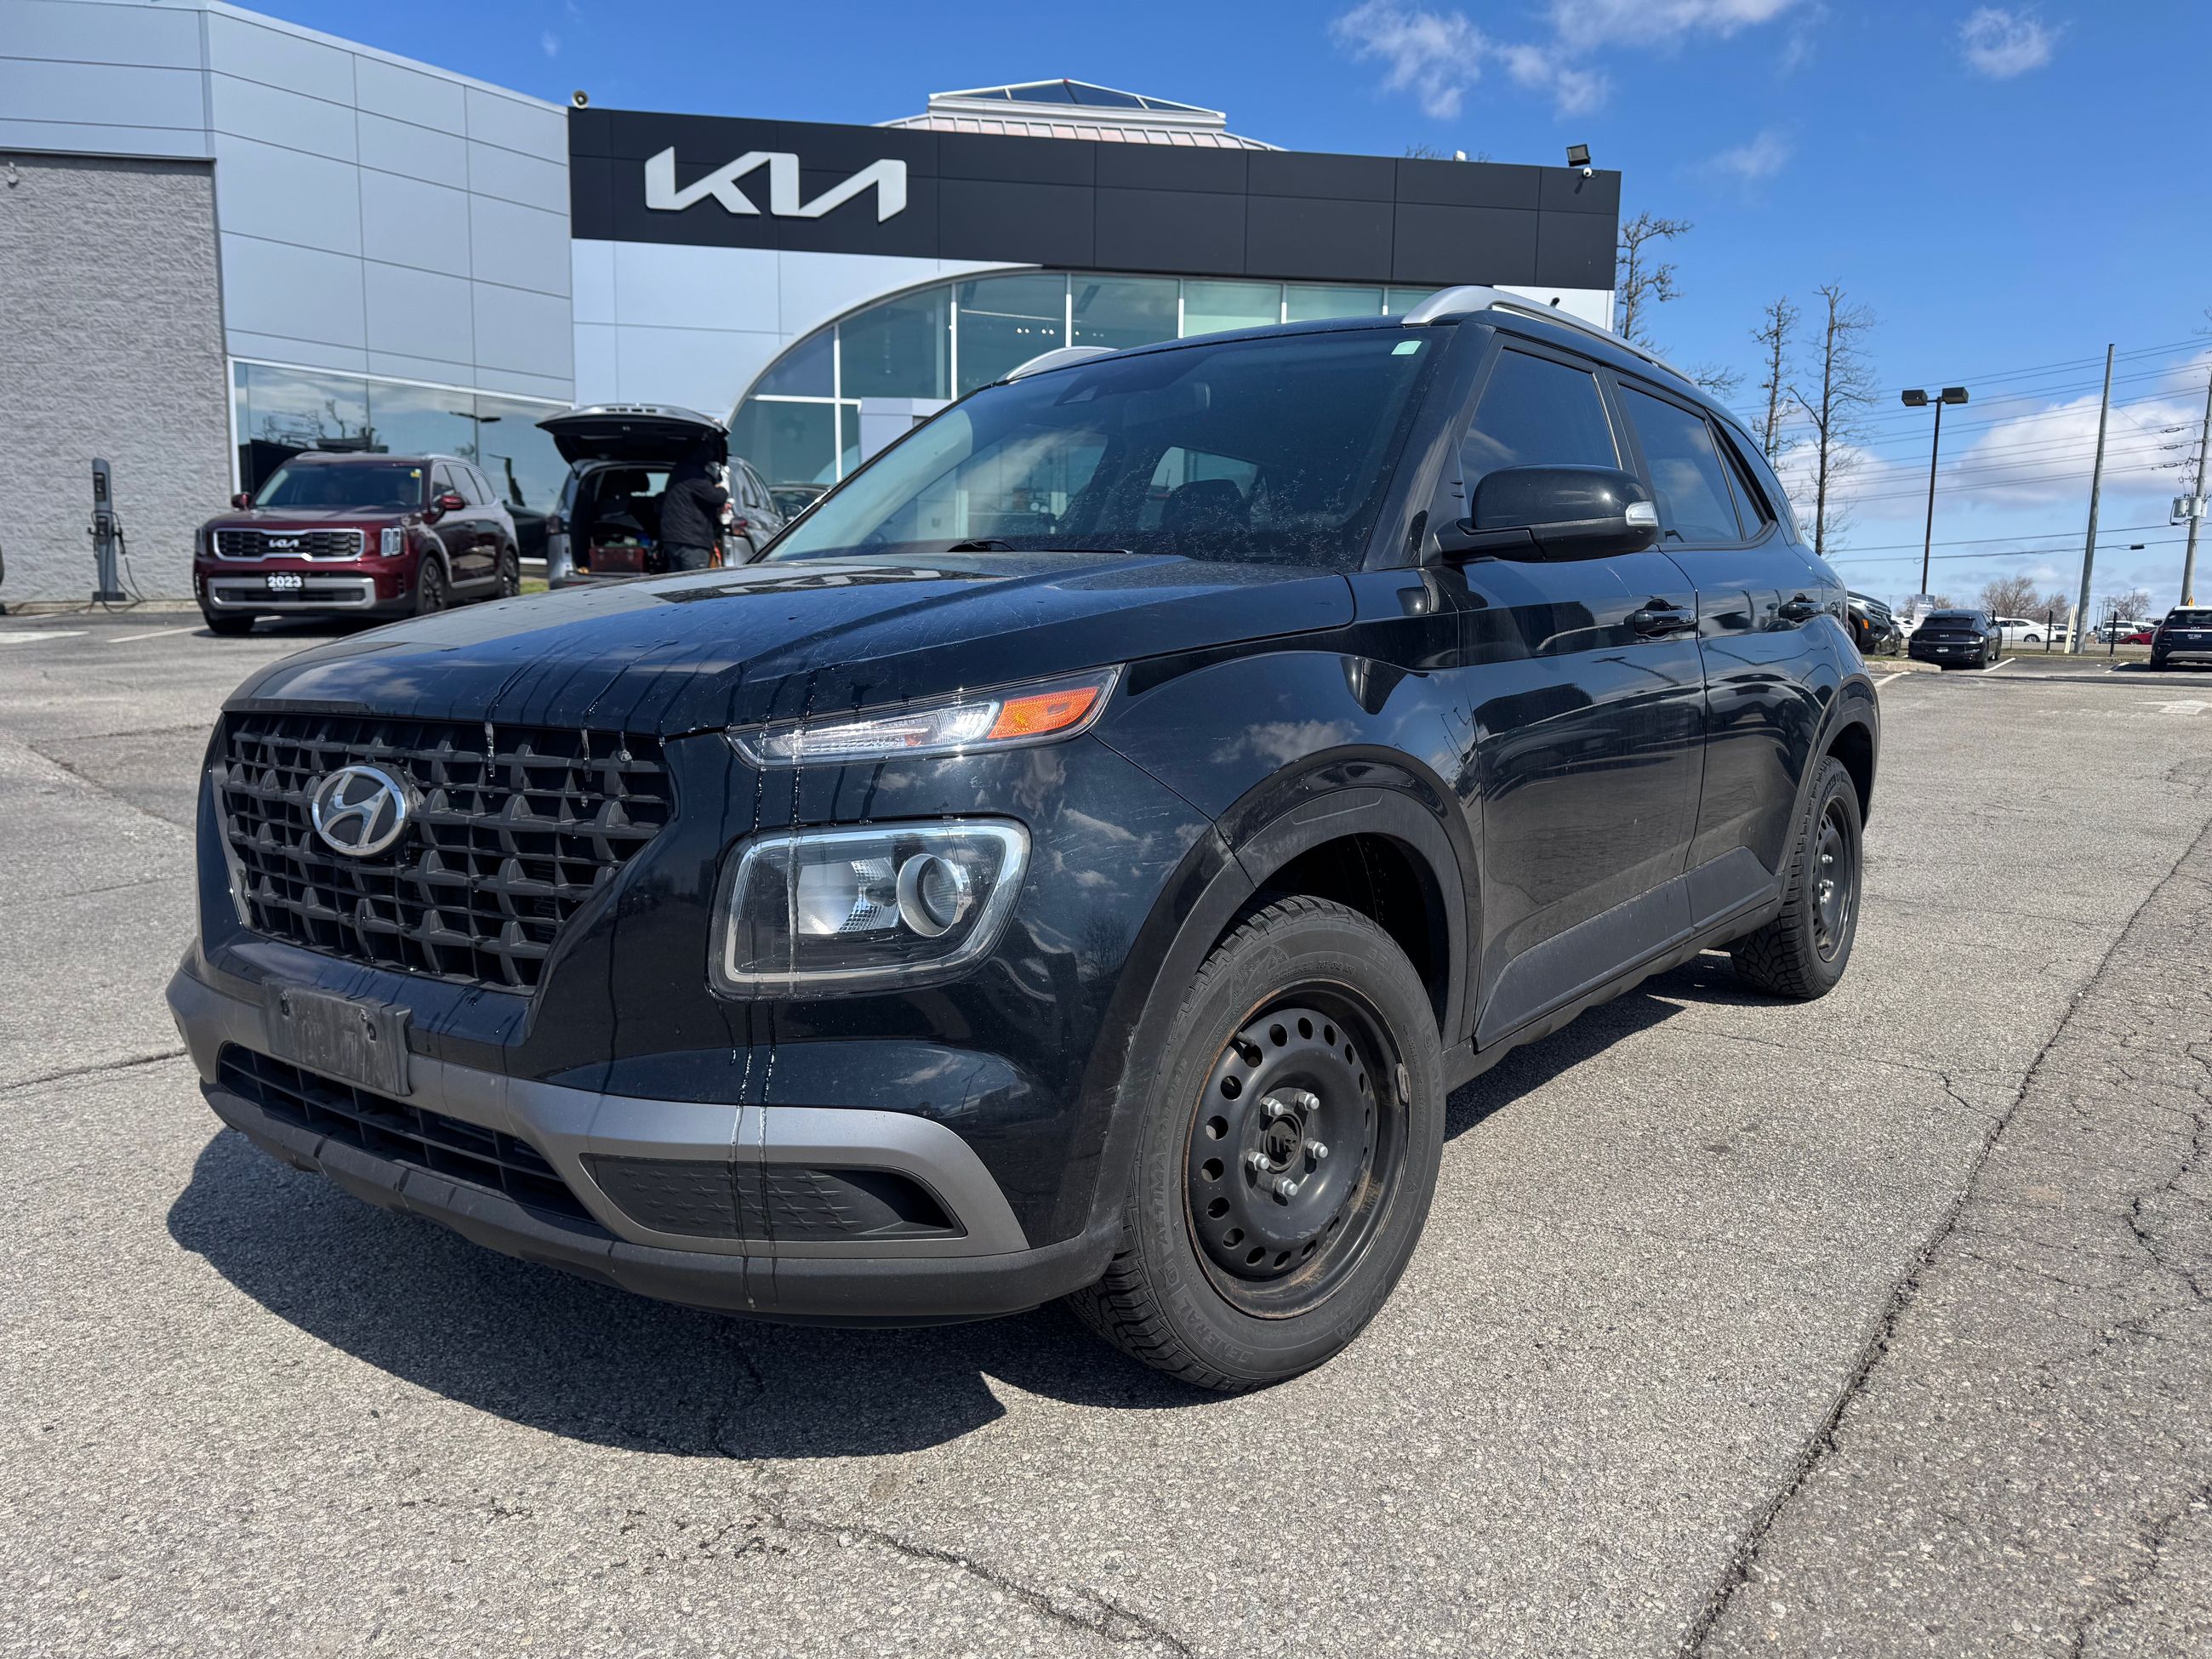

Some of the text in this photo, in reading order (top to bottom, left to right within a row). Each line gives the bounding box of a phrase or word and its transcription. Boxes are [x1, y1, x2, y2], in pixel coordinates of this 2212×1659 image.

[645, 145, 908, 224] KIA
[268, 539, 299, 548] KIA
[267, 575, 302, 587] 2023
